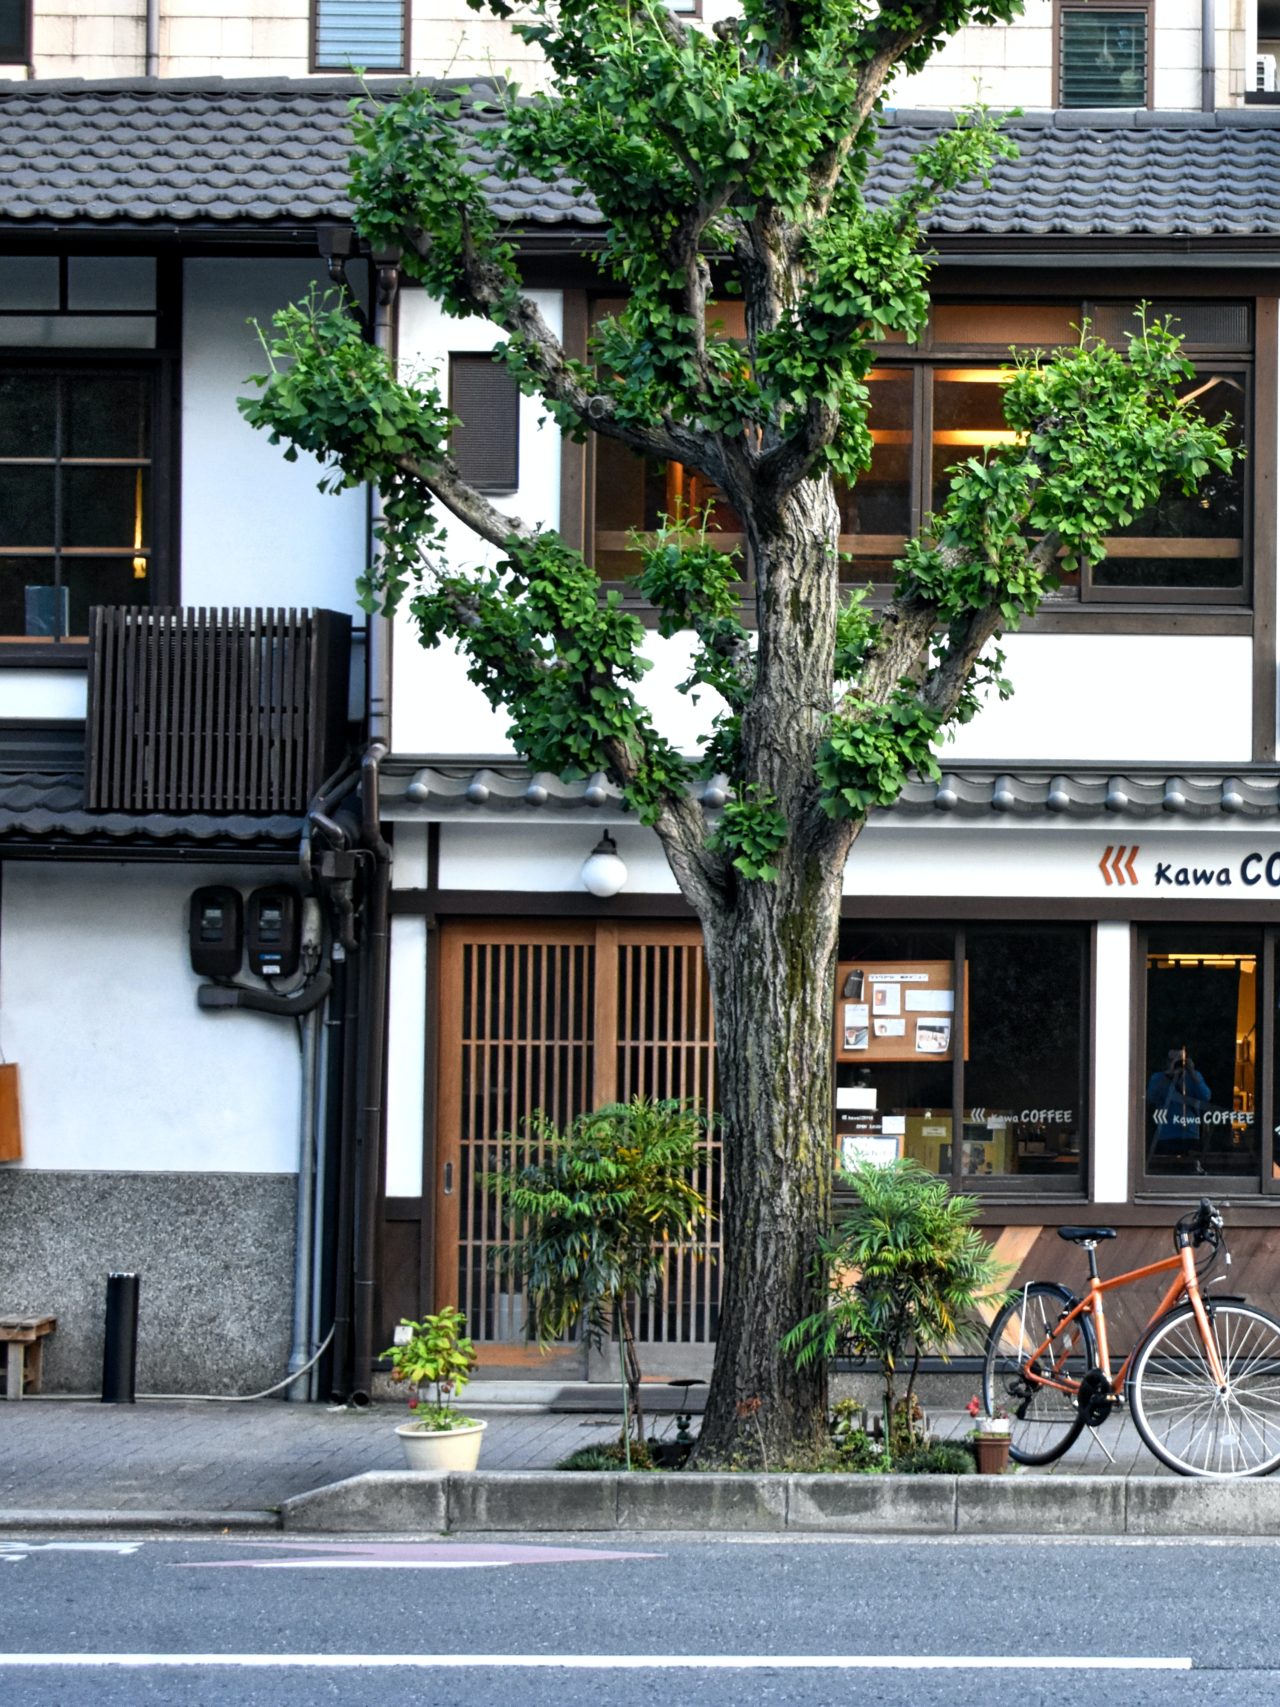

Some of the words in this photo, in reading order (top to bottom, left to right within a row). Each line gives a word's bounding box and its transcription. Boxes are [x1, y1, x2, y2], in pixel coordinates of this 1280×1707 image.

[1155, 861, 1232, 886] Kawa
[1021, 1110, 1072, 1123] COFFEE
[1173, 1115, 1201, 1125] Kawa
[1203, 1111, 1254, 1125] COFFEE
